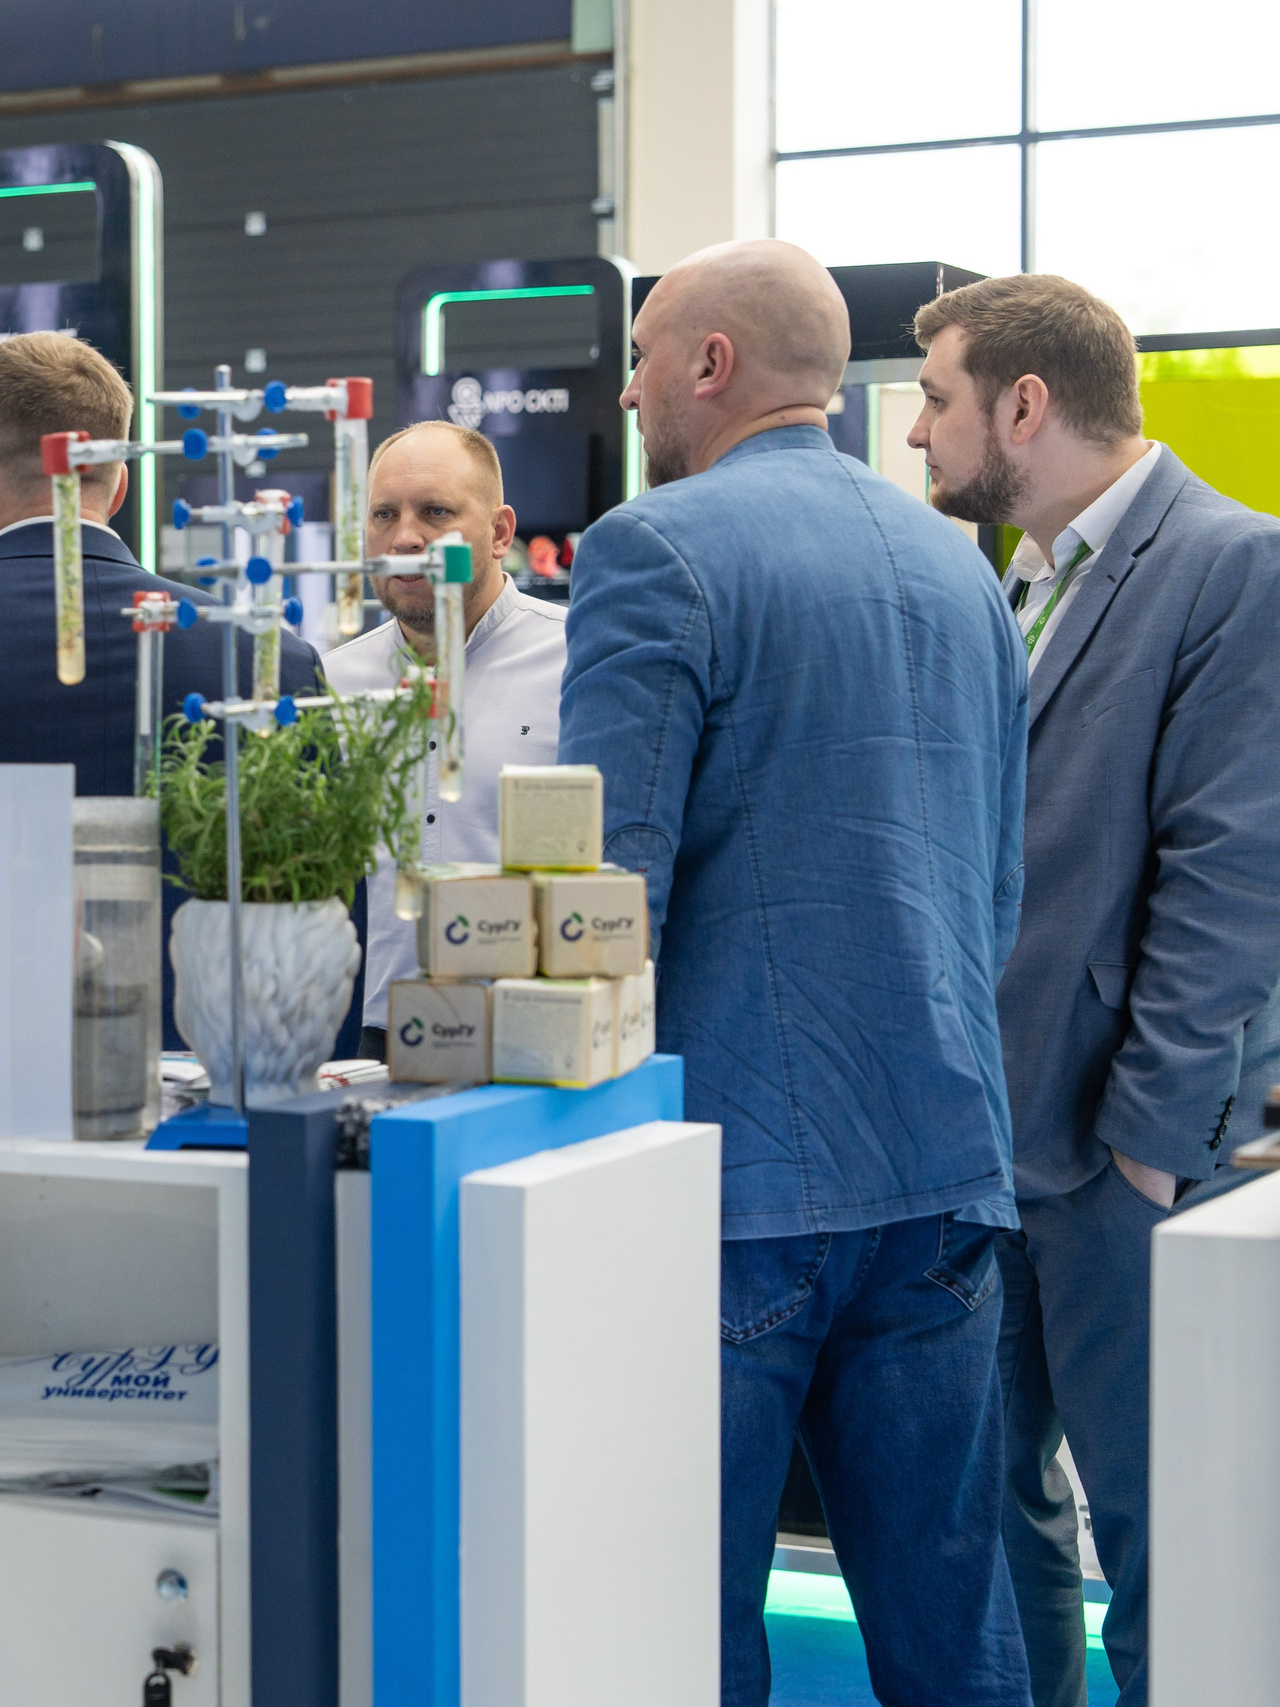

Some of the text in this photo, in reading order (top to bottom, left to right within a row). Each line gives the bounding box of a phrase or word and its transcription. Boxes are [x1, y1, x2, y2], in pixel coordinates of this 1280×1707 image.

[477, 918, 523, 935] СурГУ
[591, 914, 635, 932] СурГУ
[431, 1022, 476, 1040] СурГУ
[41, 1386, 188, 1401] университет
